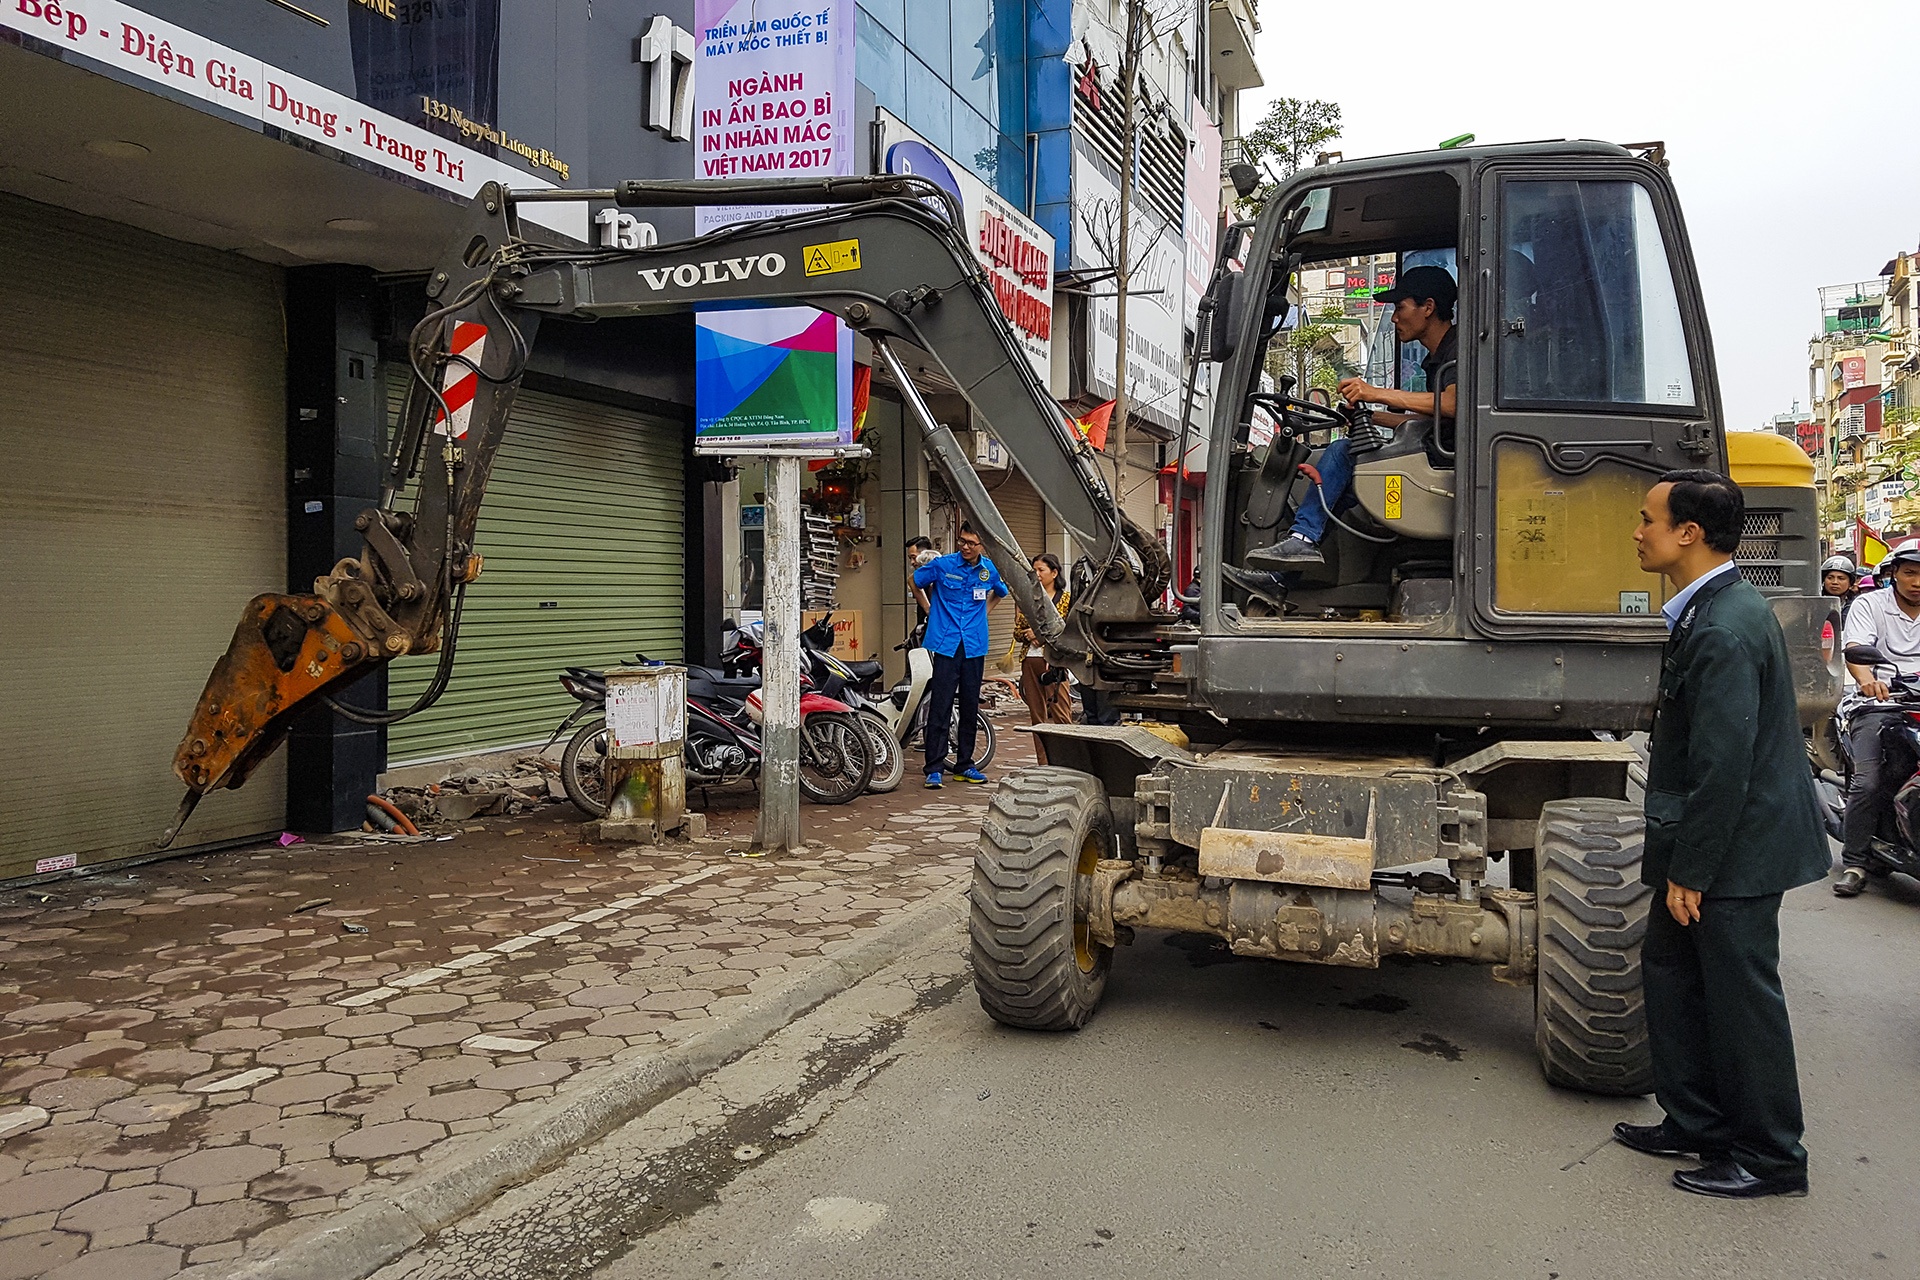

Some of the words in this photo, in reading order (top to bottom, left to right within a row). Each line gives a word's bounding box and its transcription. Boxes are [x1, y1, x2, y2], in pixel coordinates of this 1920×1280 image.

[705, 20, 737, 41] TRIỂN
[771, 11, 812, 31] QUỐC
[815, 7, 830, 26] TẾ
[706, 41, 734, 57] MÁY
[739, 36, 771, 52] MÓC
[776, 28, 812, 47] THIẾT
[816, 30, 828, 45] BỊ
[729, 71, 803, 98] NGÀNH
[121, 22, 196, 79] Điện
[205, 59, 255, 101] Gia
[267, 81, 338, 138] Dụng
[360, 119, 427, 172] Trang
[432, 148, 465, 183] Trí
[703, 109, 721, 128] IN
[728, 97, 755, 125] ẤN
[763, 99, 806, 121] BAO
[814, 91, 832, 116] BÌ
[421, 96, 449, 121] 132
[499, 129, 540, 168] Lương
[703, 134, 721, 153] IN
[725, 125, 778, 150] NHÃN
[784, 119, 832, 144] MÁC
[703, 153, 739, 179] VIỆT
[742, 152, 785, 173] NAM
[789, 148, 832, 169] 2017
[704, 213, 742, 224] PACKING
[745, 211, 763, 220] AND
[980, 210, 1014, 268] ĐIỆN
[1014, 235, 1048, 290] LẠNH
[638, 252, 787, 291] VOLVO
[1347, 277, 1367, 289] Mẹ
[1135, 334, 1150, 361] NAM
[1150, 343, 1165, 370] XUẤT
[1165, 352, 1180, 379] KHẨU
